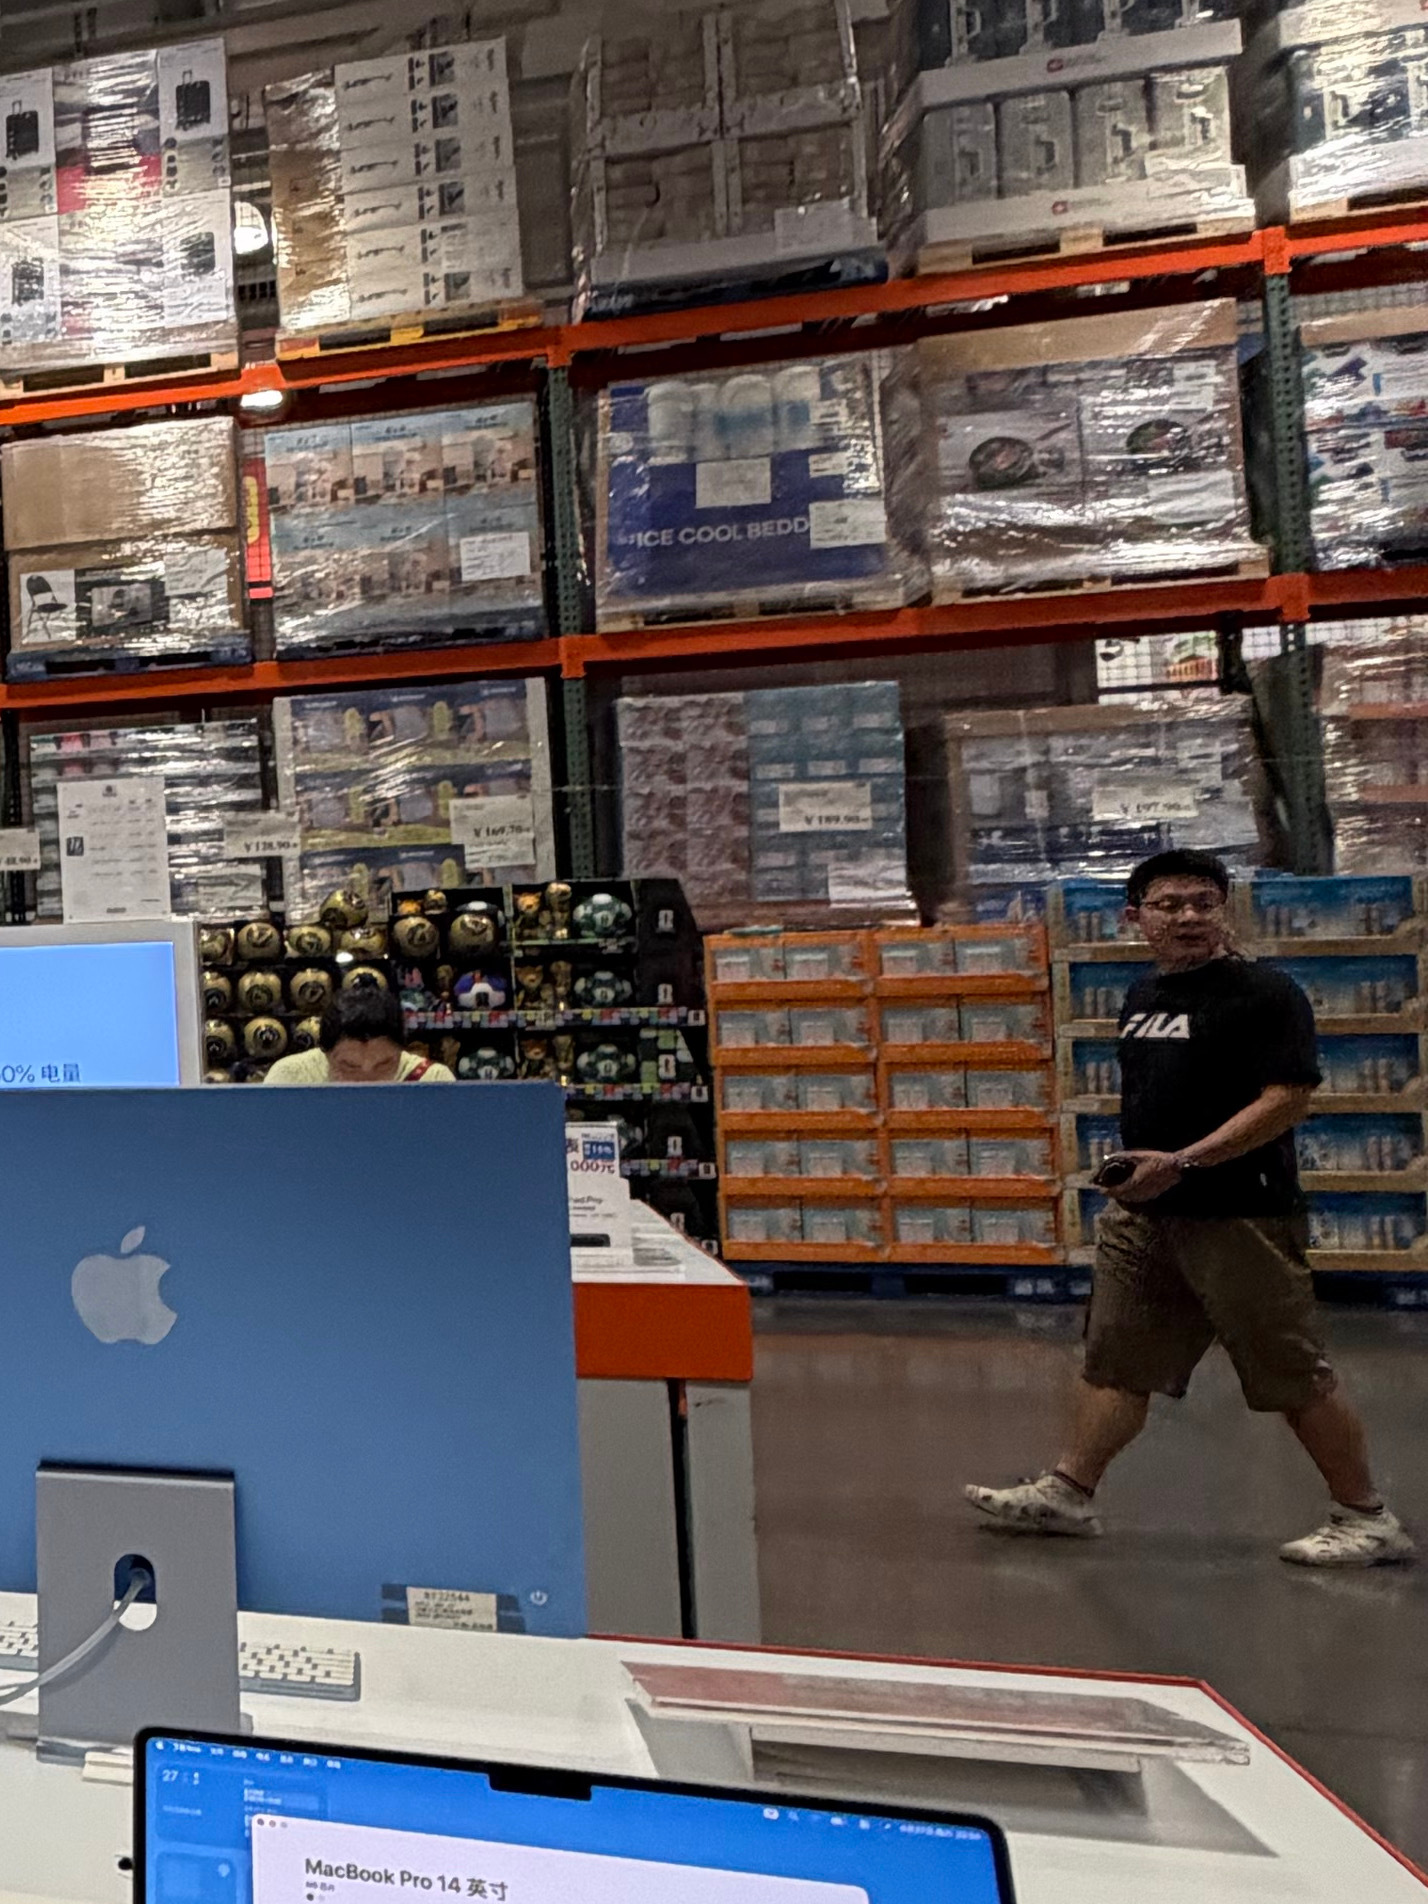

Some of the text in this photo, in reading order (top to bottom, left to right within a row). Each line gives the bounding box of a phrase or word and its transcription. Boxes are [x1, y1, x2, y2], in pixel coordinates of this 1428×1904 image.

[678, 524, 740, 545] COOL
[746, 517, 811, 540] BEDD
[1119, 1013, 1190, 1039] FILA
[41, 1062, 82, 1084] 电量
[304, 1857, 509, 1902] MacBook Pro 14 英寸
